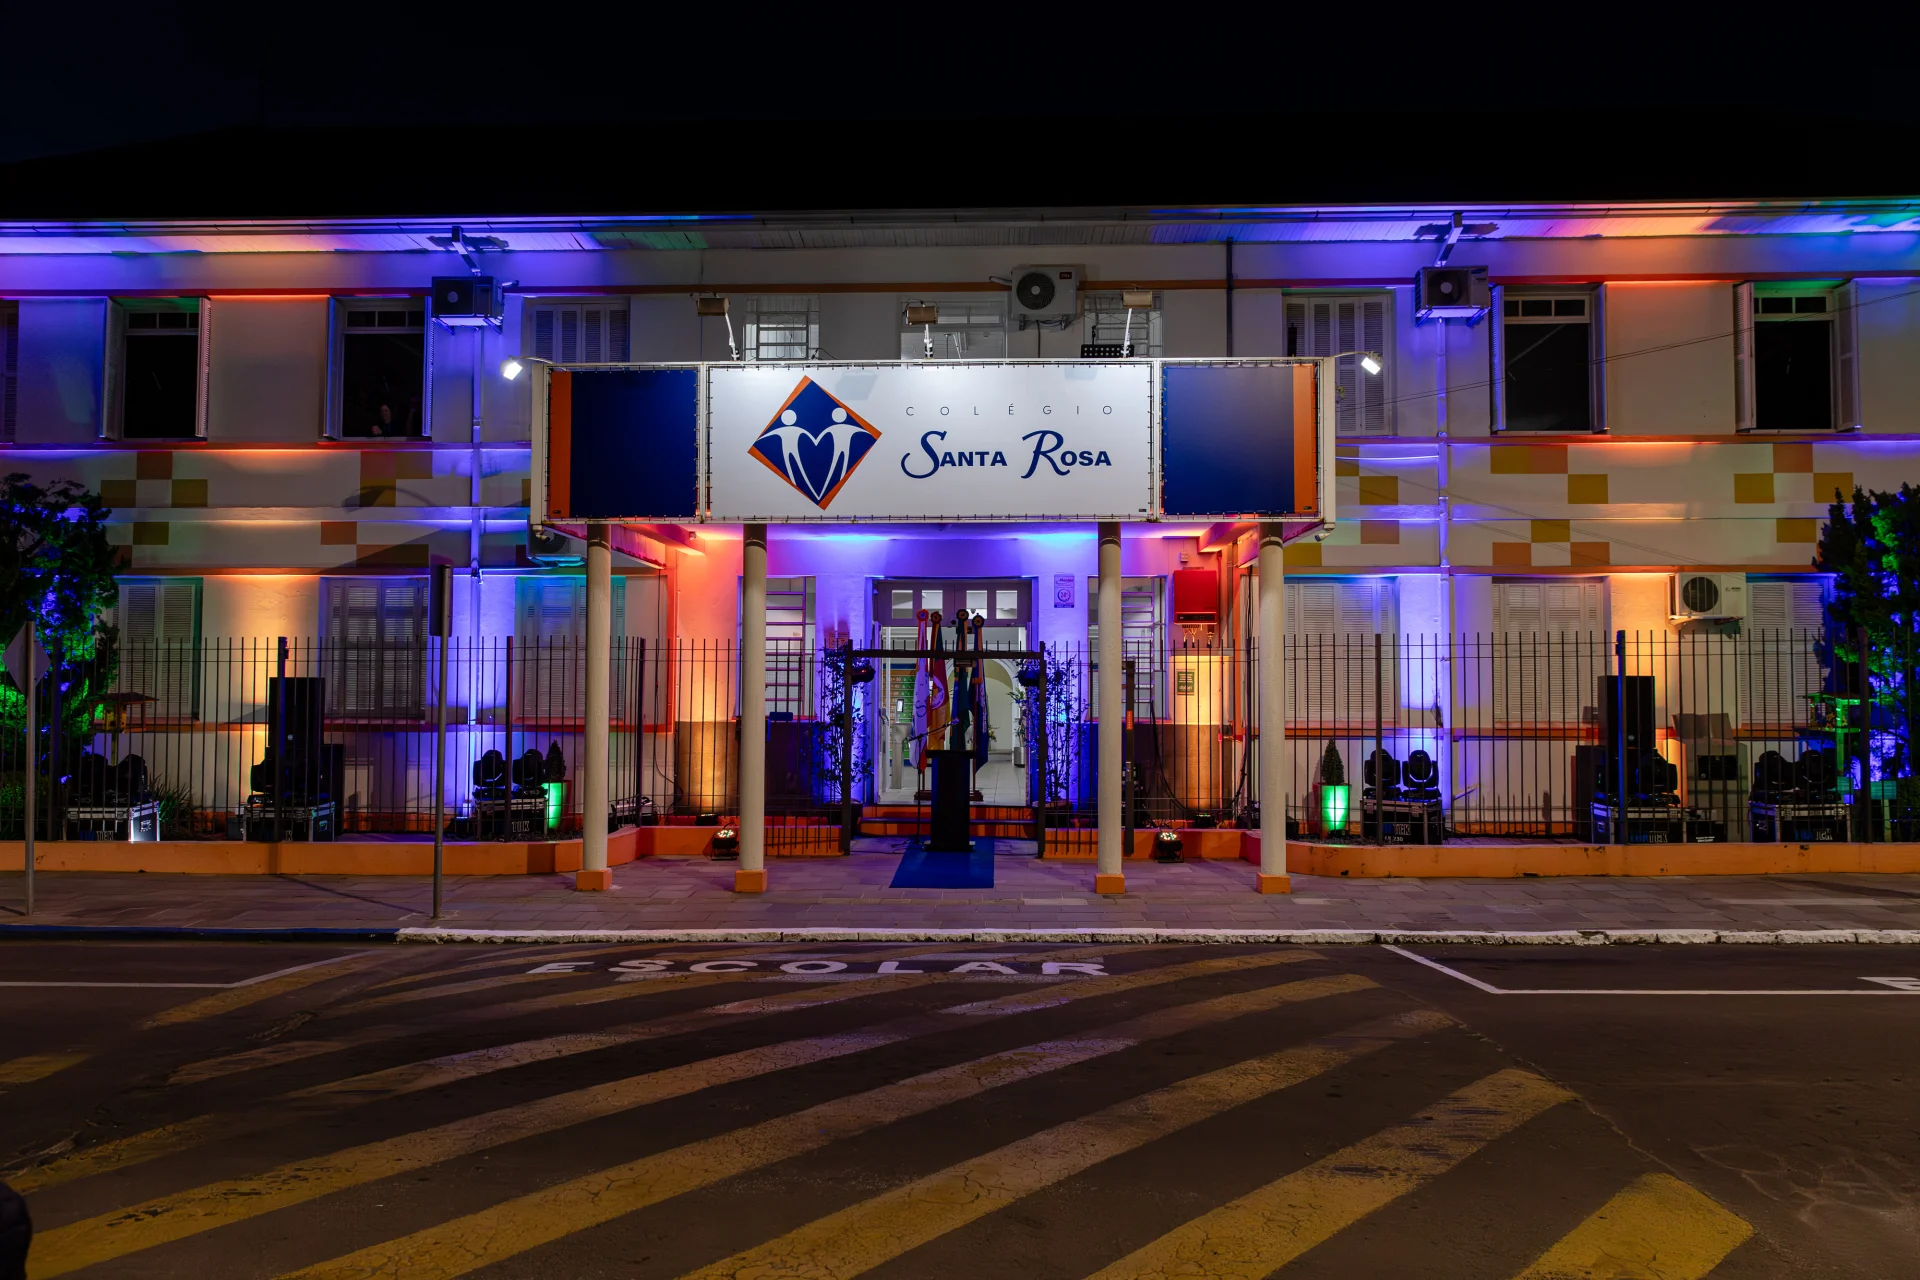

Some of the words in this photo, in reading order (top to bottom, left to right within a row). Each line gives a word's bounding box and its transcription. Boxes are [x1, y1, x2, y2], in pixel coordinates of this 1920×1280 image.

[905, 403, 1113, 416] COLÉGIO
[900, 430, 1008, 479] SANTA
[1020, 429, 1113, 479] ROSA
[526, 960, 1109, 976] ESCOLAR
